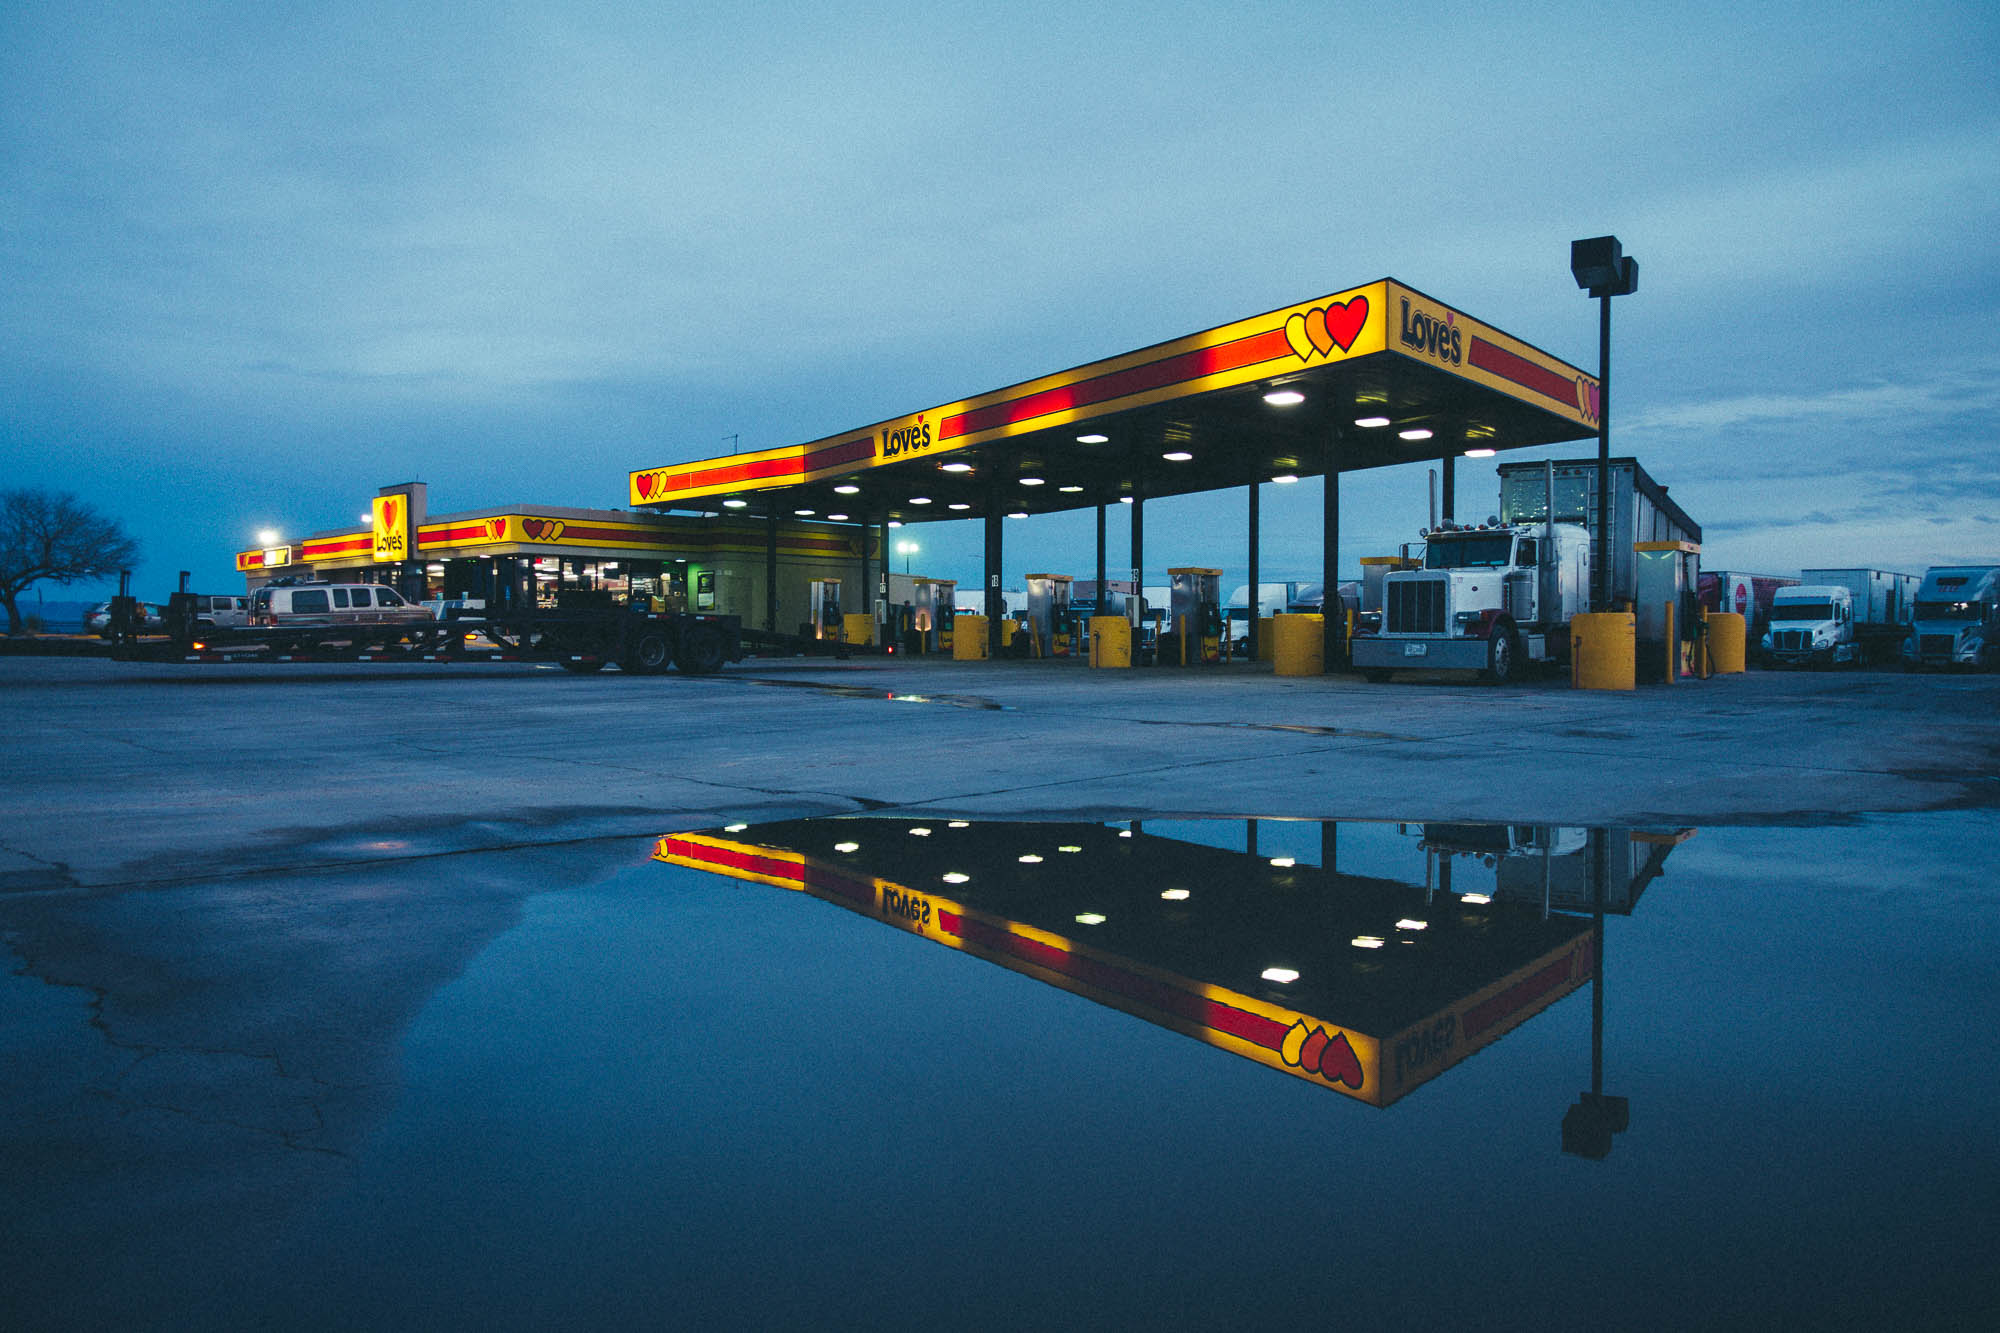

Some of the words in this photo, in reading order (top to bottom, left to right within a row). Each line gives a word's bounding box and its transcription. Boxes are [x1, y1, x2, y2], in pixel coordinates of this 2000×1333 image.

[1401, 298, 1461, 366] Love's
[882, 416, 931, 458] Love's
[376, 530, 402, 551] Love's
